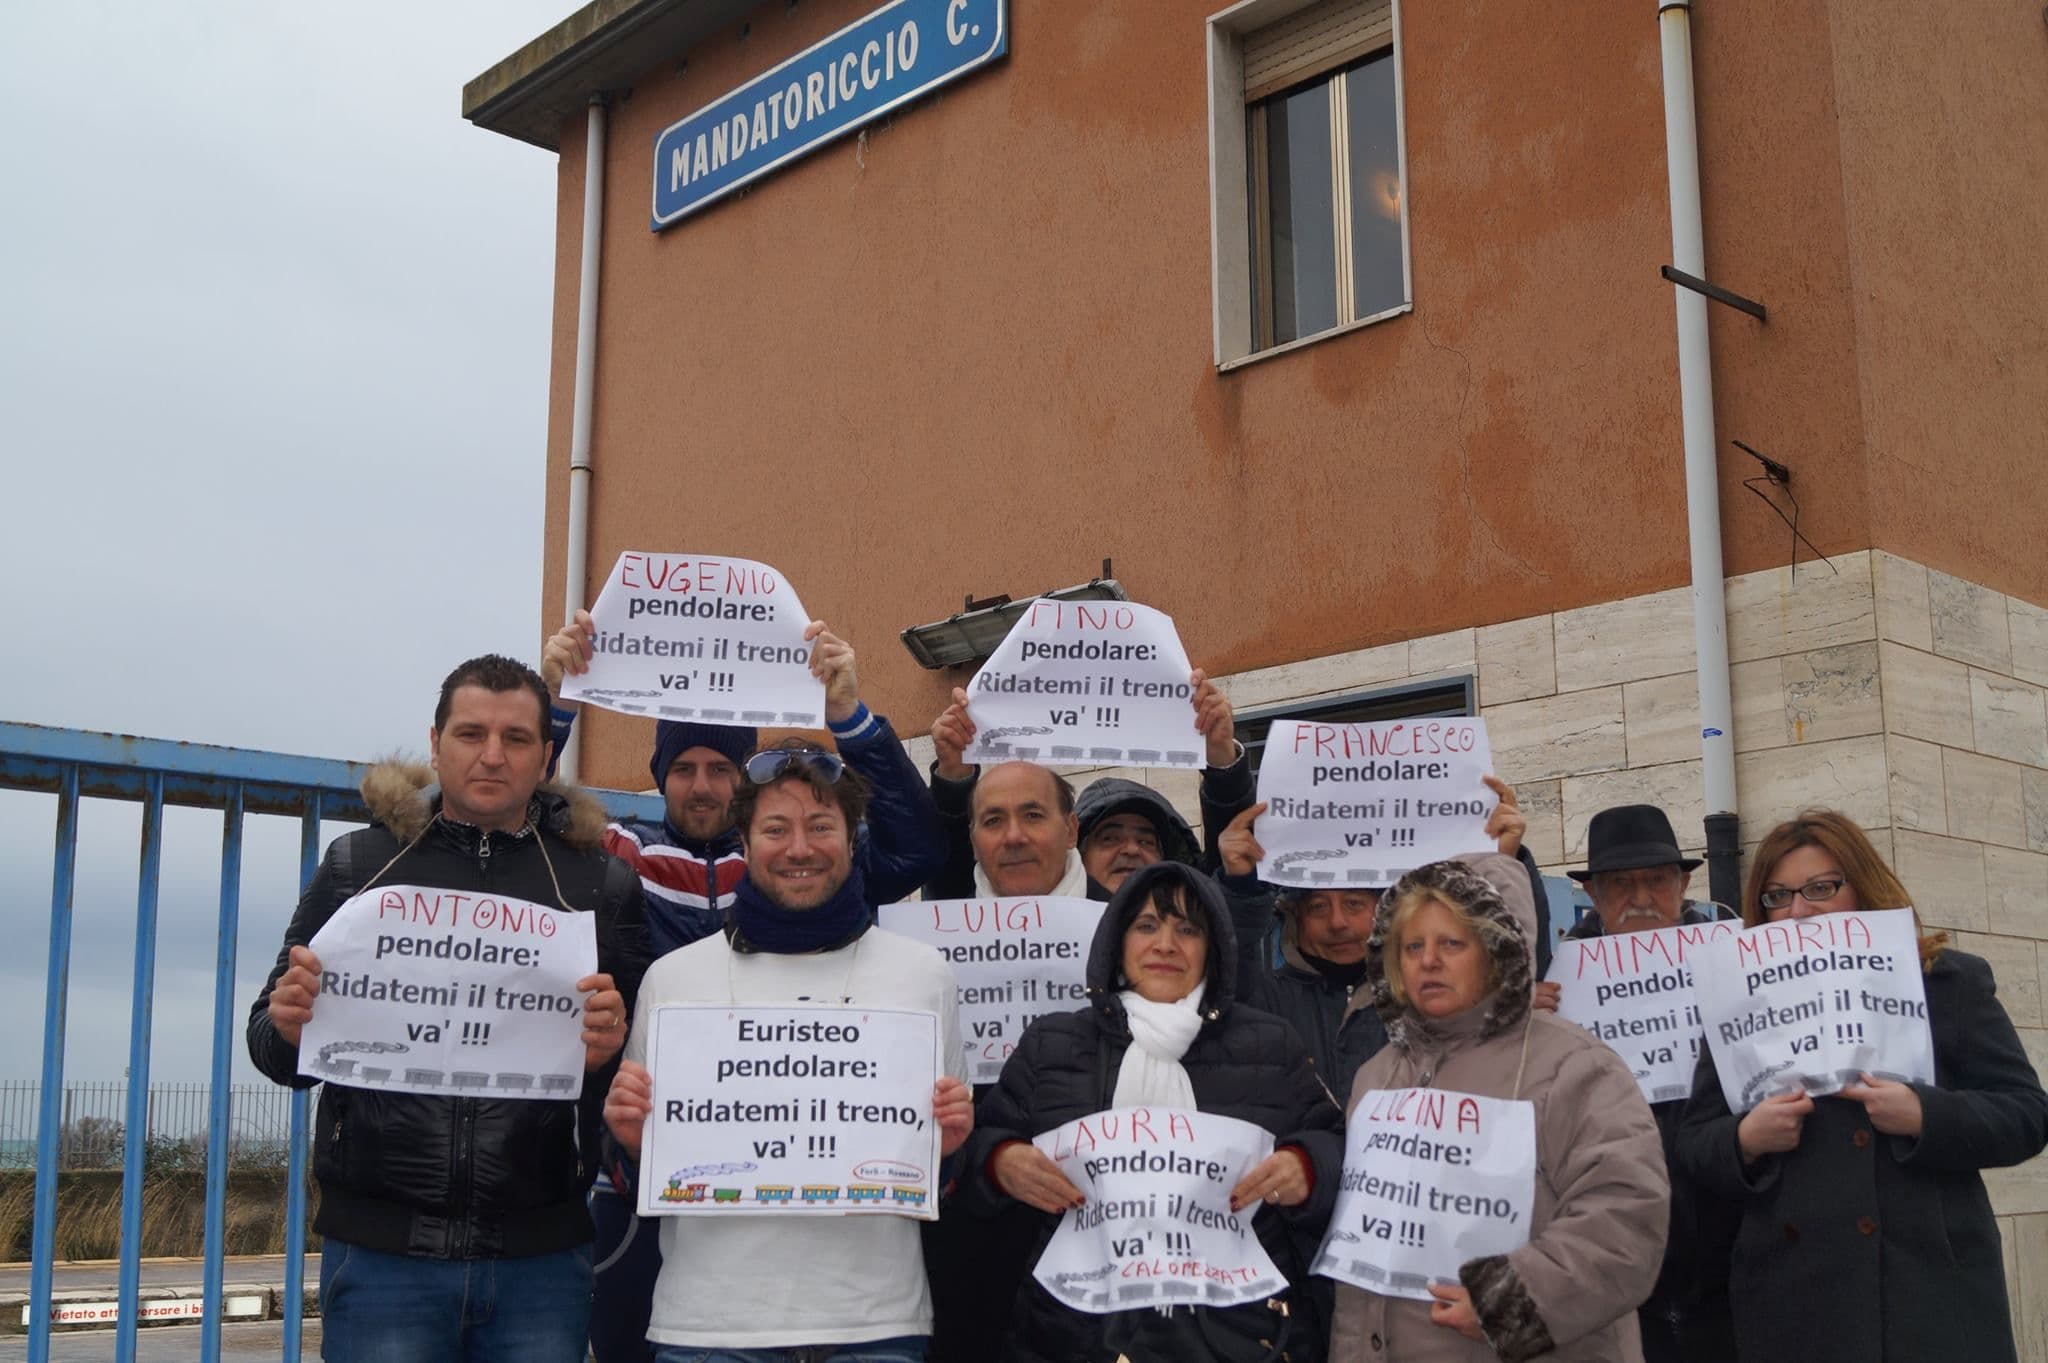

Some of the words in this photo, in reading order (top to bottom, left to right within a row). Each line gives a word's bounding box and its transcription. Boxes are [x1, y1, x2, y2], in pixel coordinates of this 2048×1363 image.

[671, 20, 919, 193] MANDATORICCIO
[946, 0, 980, 46] C.
[622, 555, 776, 595] EUGENIO
[628, 596, 775, 622] pendolare:
[1030, 602, 1136, 630] TINO
[713, 637, 729, 661] il
[736, 640, 809, 666] treno
[1021, 640, 1157, 661] pendolare:
[659, 670, 699, 691] va'
[709, 672, 735, 692] !!!
[977, 672, 1091, 695] Ridatemi
[1100, 677, 1114, 696] il
[1050, 706, 1086, 726] va'
[1096, 707, 1121, 727] !!!
[1294, 723, 1476, 759] FRANCESCO
[1313, 760, 1449, 786] pendolare:
[1270, 797, 1385, 820] Ridatemi
[1394, 799, 1408, 819] il
[1417, 799, 1491, 819] treno,
[1344, 828, 1380, 847] va'
[1391, 828, 1415, 847] !!!
[379, 890, 557, 938] ANTONIO
[933, 900, 1045, 933] LUIGI
[375, 935, 540, 967] pendolare:
[1736, 916, 1873, 969] MARIA
[1746, 951, 1894, 996] pendolare:
[320, 970, 459, 1007] Ridatemi
[467, 984, 487, 1009] il
[495, 987, 581, 1019] treno,
[1022, 979, 1037, 1002] il
[972, 1014, 1010, 1039] va'
[1685, 1005, 1702, 1027] il
[1718, 992, 1825, 1046] Ridatemi
[1834, 989, 1851, 1012] il
[407, 1019, 450, 1044] va'
[461, 1022, 491, 1046] !!!
[738, 1019, 860, 1044] Euristeo
[1789, 1025, 1824, 1056] va'
[1835, 1023, 1865, 1045] !!!
[1642, 1040, 1679, 1067] va'
[717, 1054, 878, 1083] pendolare:
[665, 1099, 799, 1124] Ridatemi
[810, 1099, 827, 1123] il
[837, 1100, 925, 1132] treno,
[753, 1135, 795, 1159] va'
[807, 1135, 837, 1159] !!!
[1053, 1108, 1194, 1162] LAURA
[1084, 1150, 1228, 1183] pendolare:
[1167, 1195, 1183, 1219] il
[1186, 1205, 1245, 1239] treno,
[1428, 1186, 1520, 1225] treno,
[1111, 1231, 1153, 1258] va'
[1165, 1232, 1192, 1257] !!!
[1398, 1221, 1426, 1249] !!!
[50, 1309, 96, 1320] Vietato
[184, 1304, 188, 1314] i
